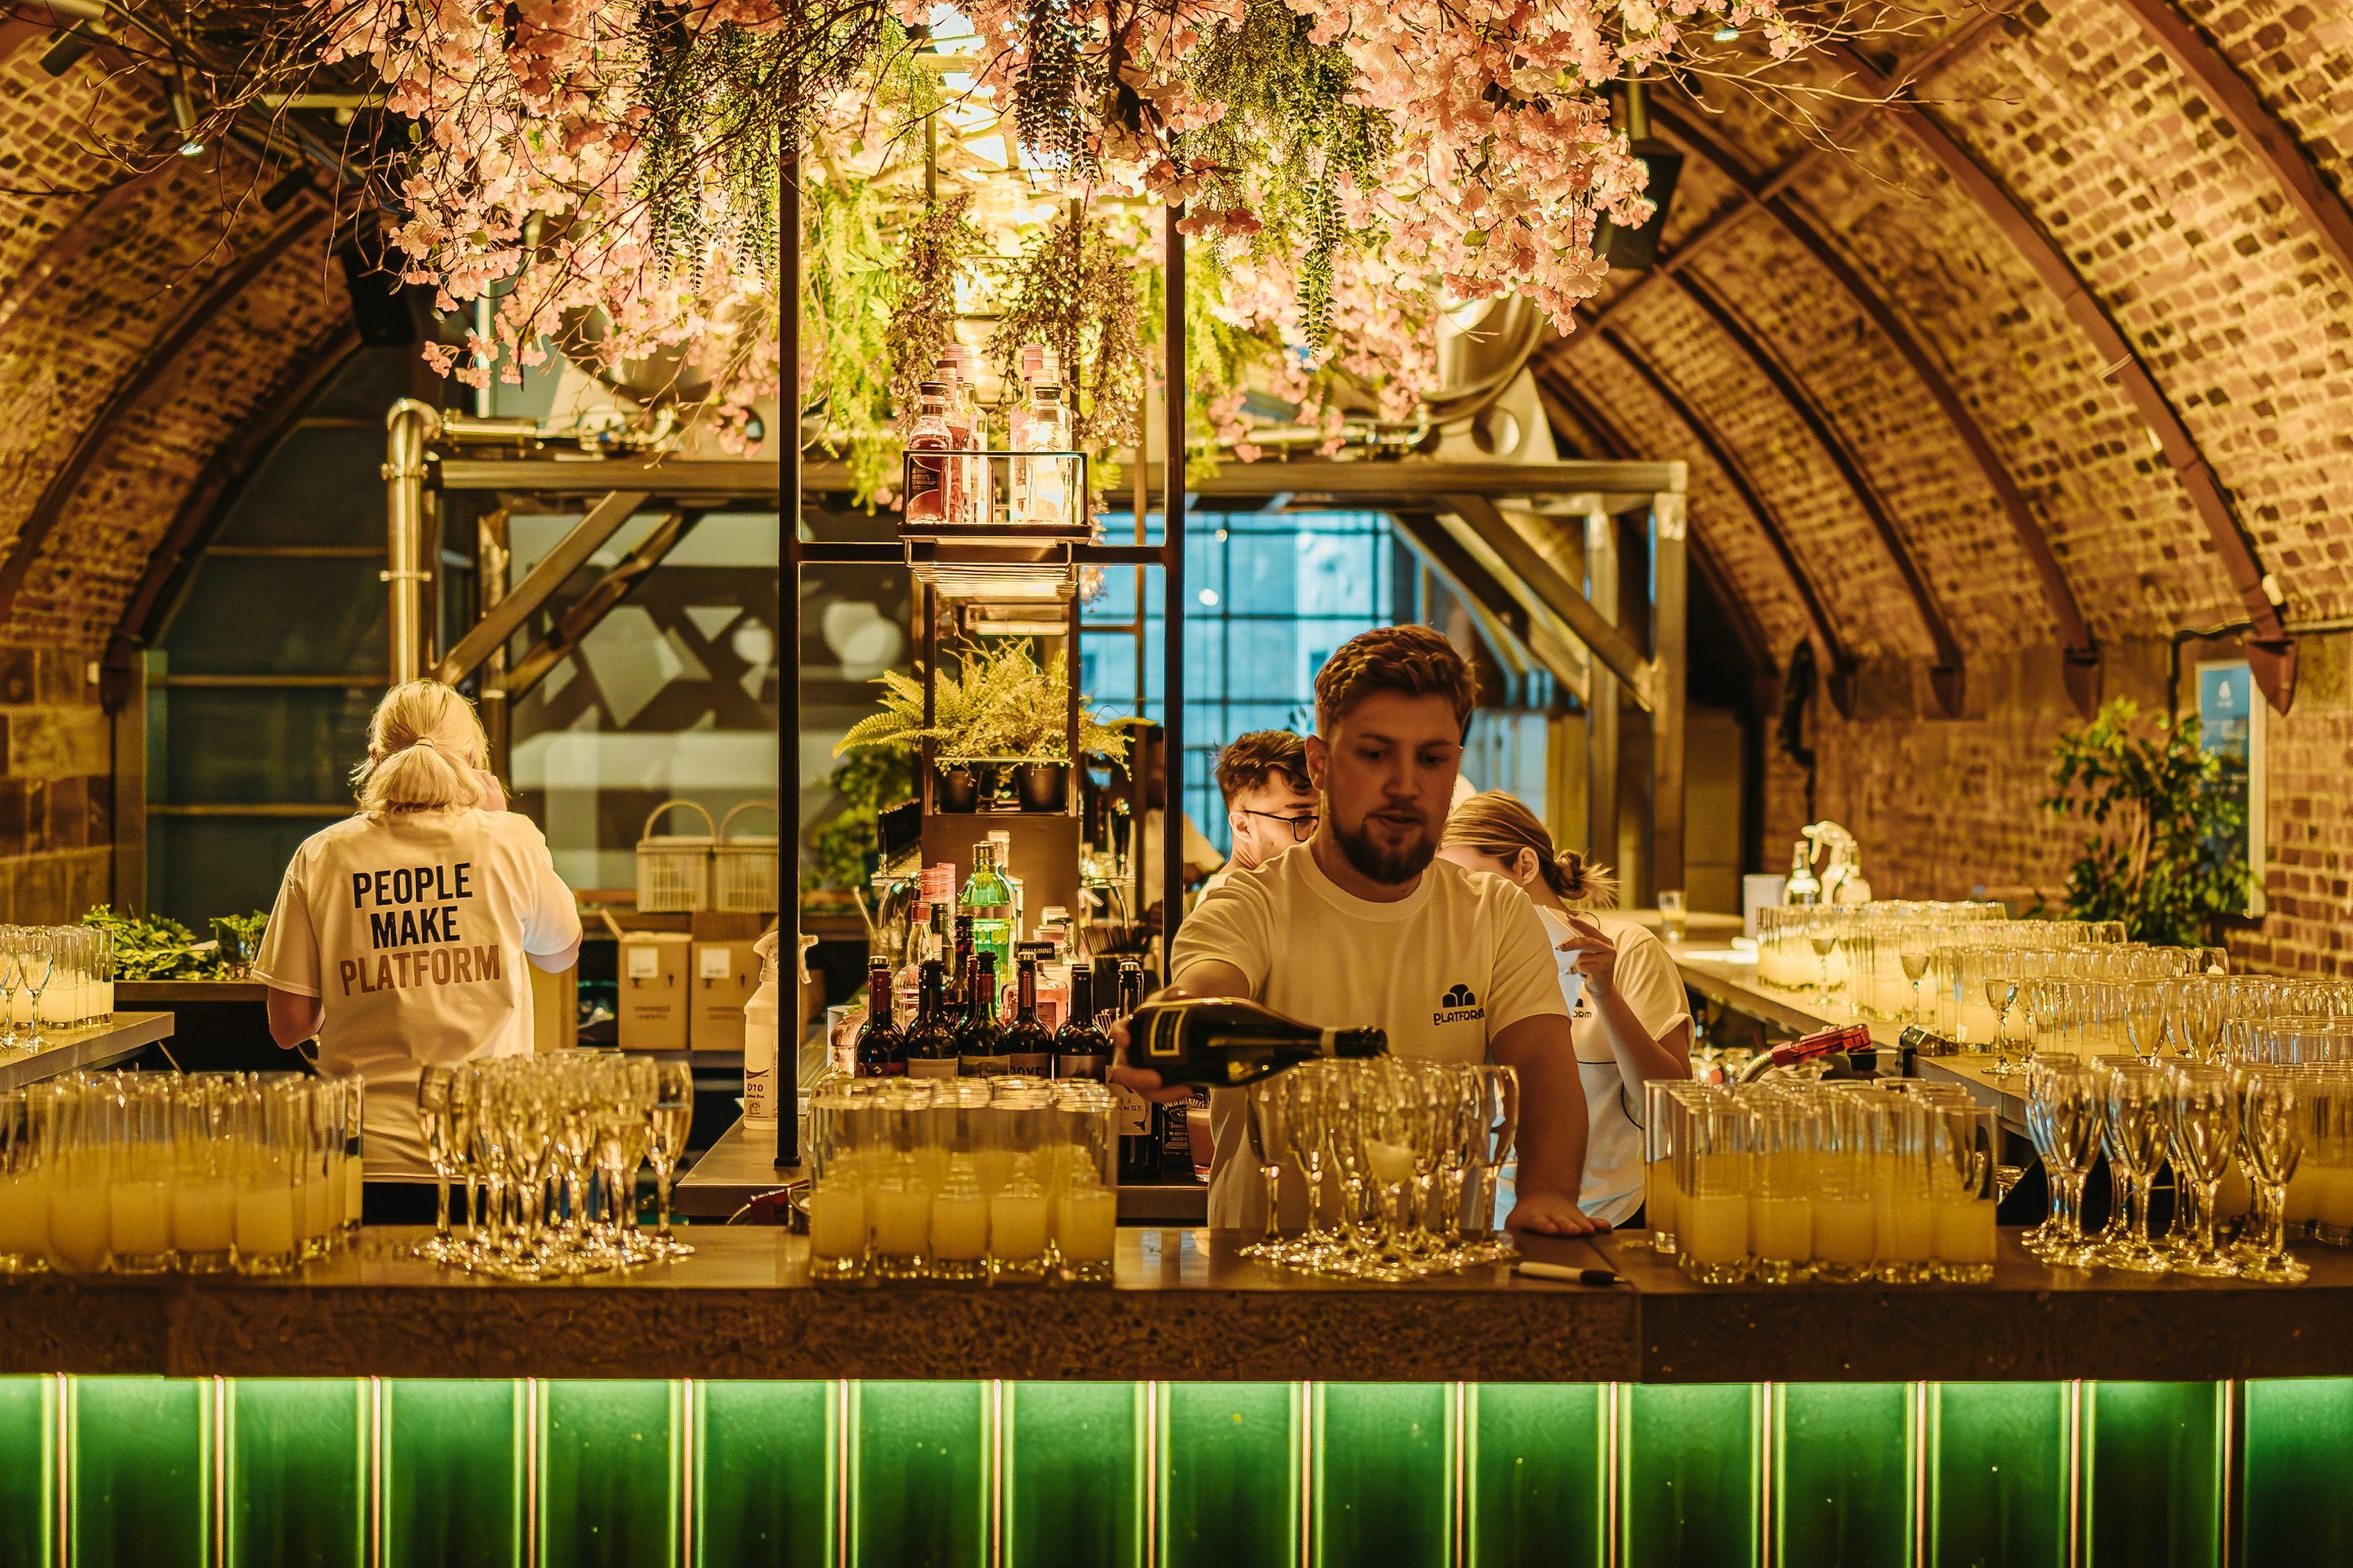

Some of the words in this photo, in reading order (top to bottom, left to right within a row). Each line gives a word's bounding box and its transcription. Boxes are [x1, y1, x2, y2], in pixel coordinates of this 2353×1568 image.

[352, 862, 473, 909] PEOPLE
[369, 905, 461, 950] MAKE
[339, 944, 500, 997] PLATFORM
[1433, 1007, 1485, 1026] PLATFORM
